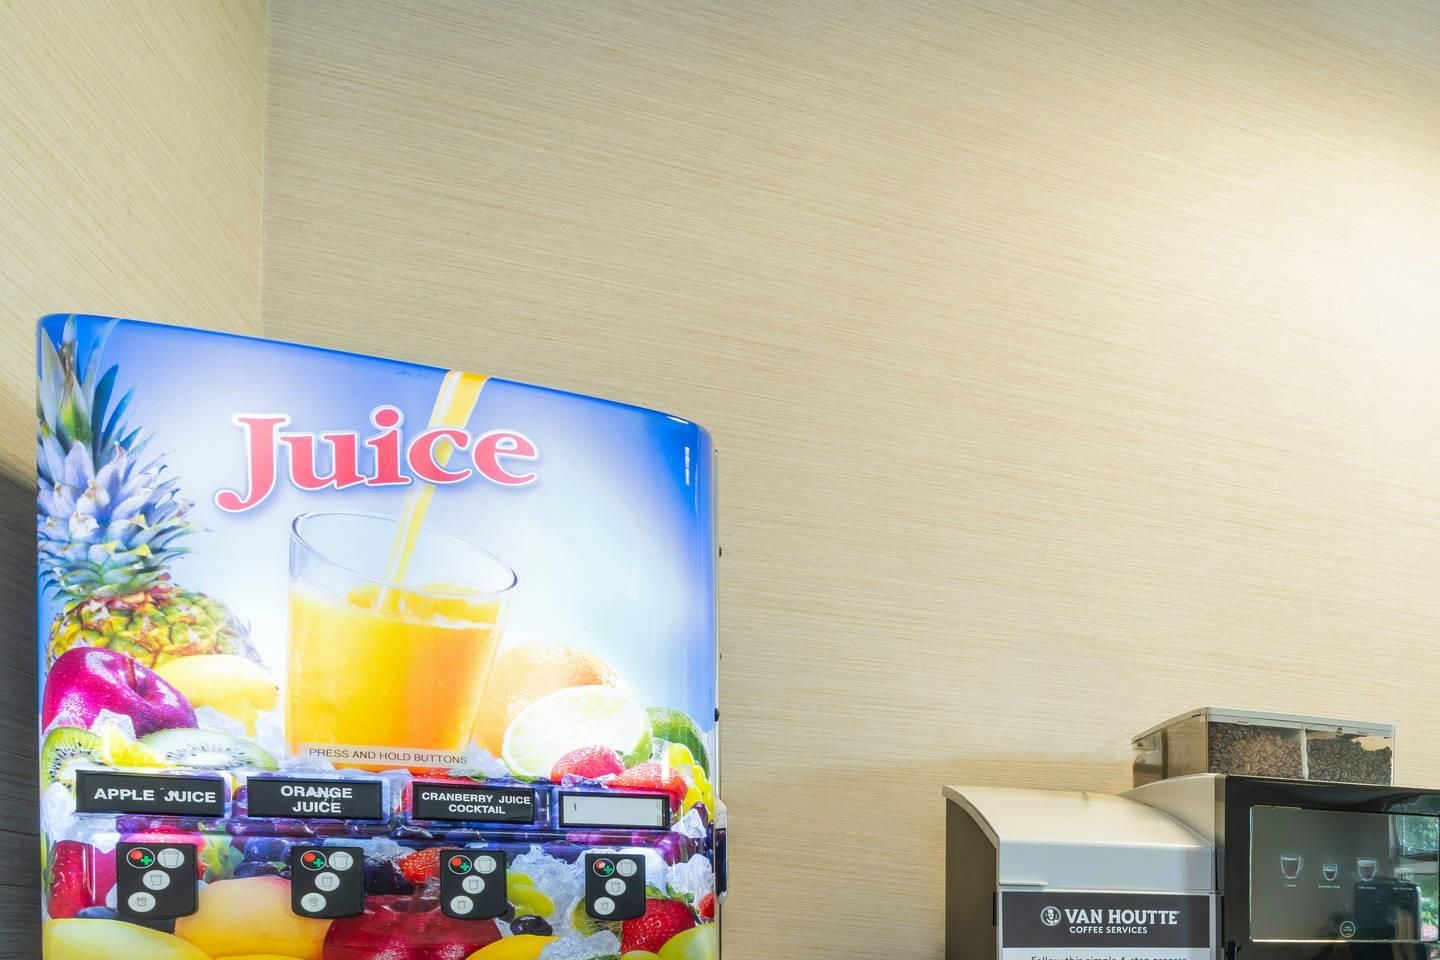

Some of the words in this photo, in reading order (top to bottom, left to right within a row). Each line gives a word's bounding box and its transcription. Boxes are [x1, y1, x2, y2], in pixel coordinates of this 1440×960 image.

[214, 404, 537, 512] Juice
[308, 747, 349, 758] PRESS
[352, 750, 376, 760] AND
[379, 751, 411, 761] HOLD
[414, 753, 468, 765] BUTTONS
[93, 787, 155, 802] APPLE
[163, 789, 217, 804] JUICE
[279, 784, 354, 800] ORANGE
[421, 791, 494, 804] CRANBERRY
[498, 793, 532, 805] JUICE
[291, 801, 342, 814] JUICE
[448, 804, 506, 815] COCKTAIL
[1064, 908, 1103, 925] VAN
[1107, 909, 1179, 926] HOUTTE
[1069, 926, 1104, 934] COFFEE
[1105, 926, 1148, 935] SERVICES
